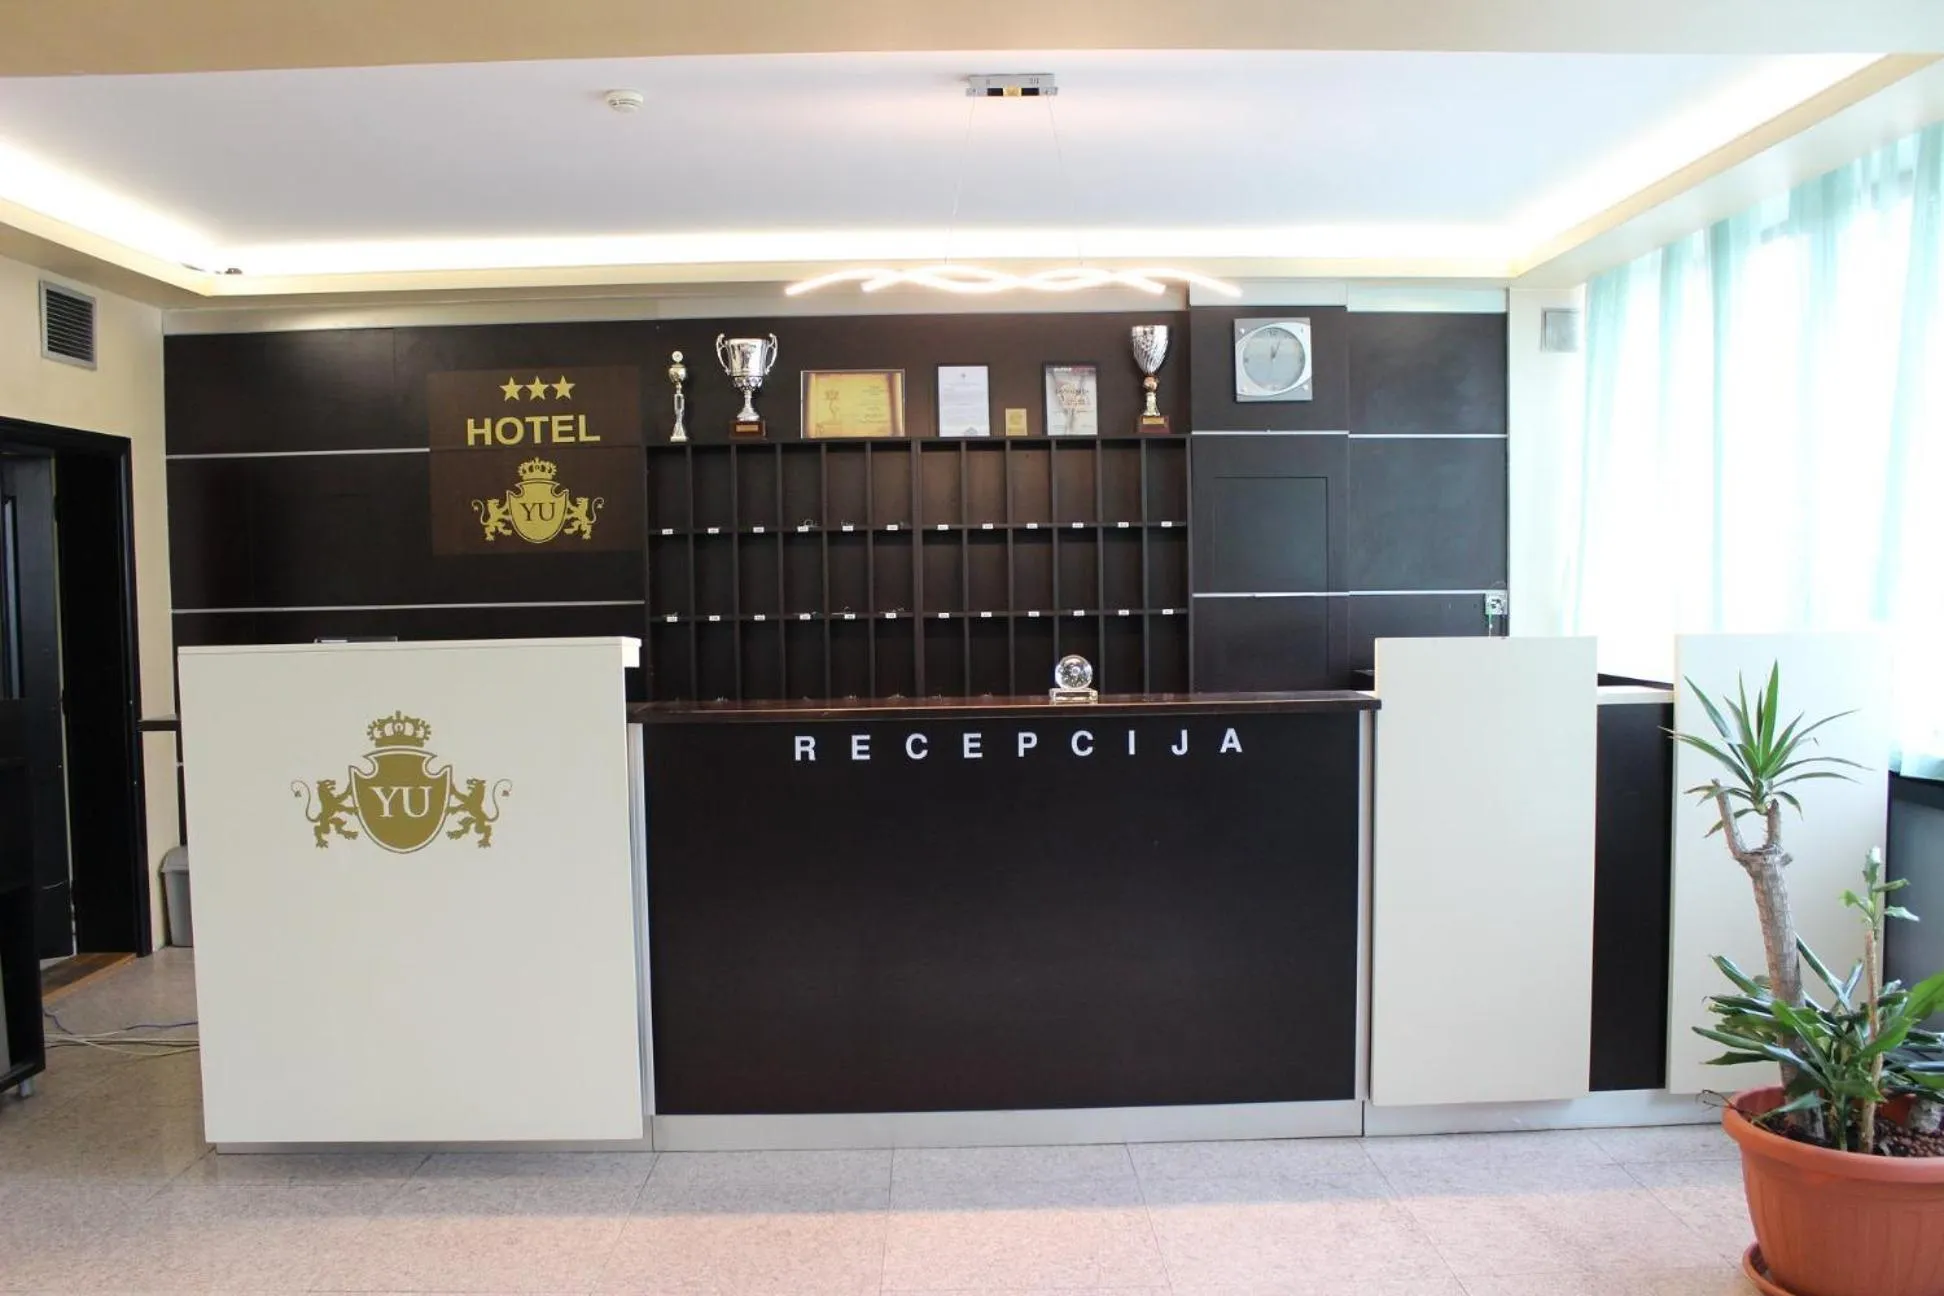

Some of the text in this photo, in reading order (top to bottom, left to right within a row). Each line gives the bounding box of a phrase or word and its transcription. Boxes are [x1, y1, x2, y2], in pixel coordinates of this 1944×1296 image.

[467, 414, 601, 446] HOTEL
[520, 502, 555, 522] YU
[794, 728, 1243, 761] RECEPCIJA
[371, 786, 432, 818] YU
